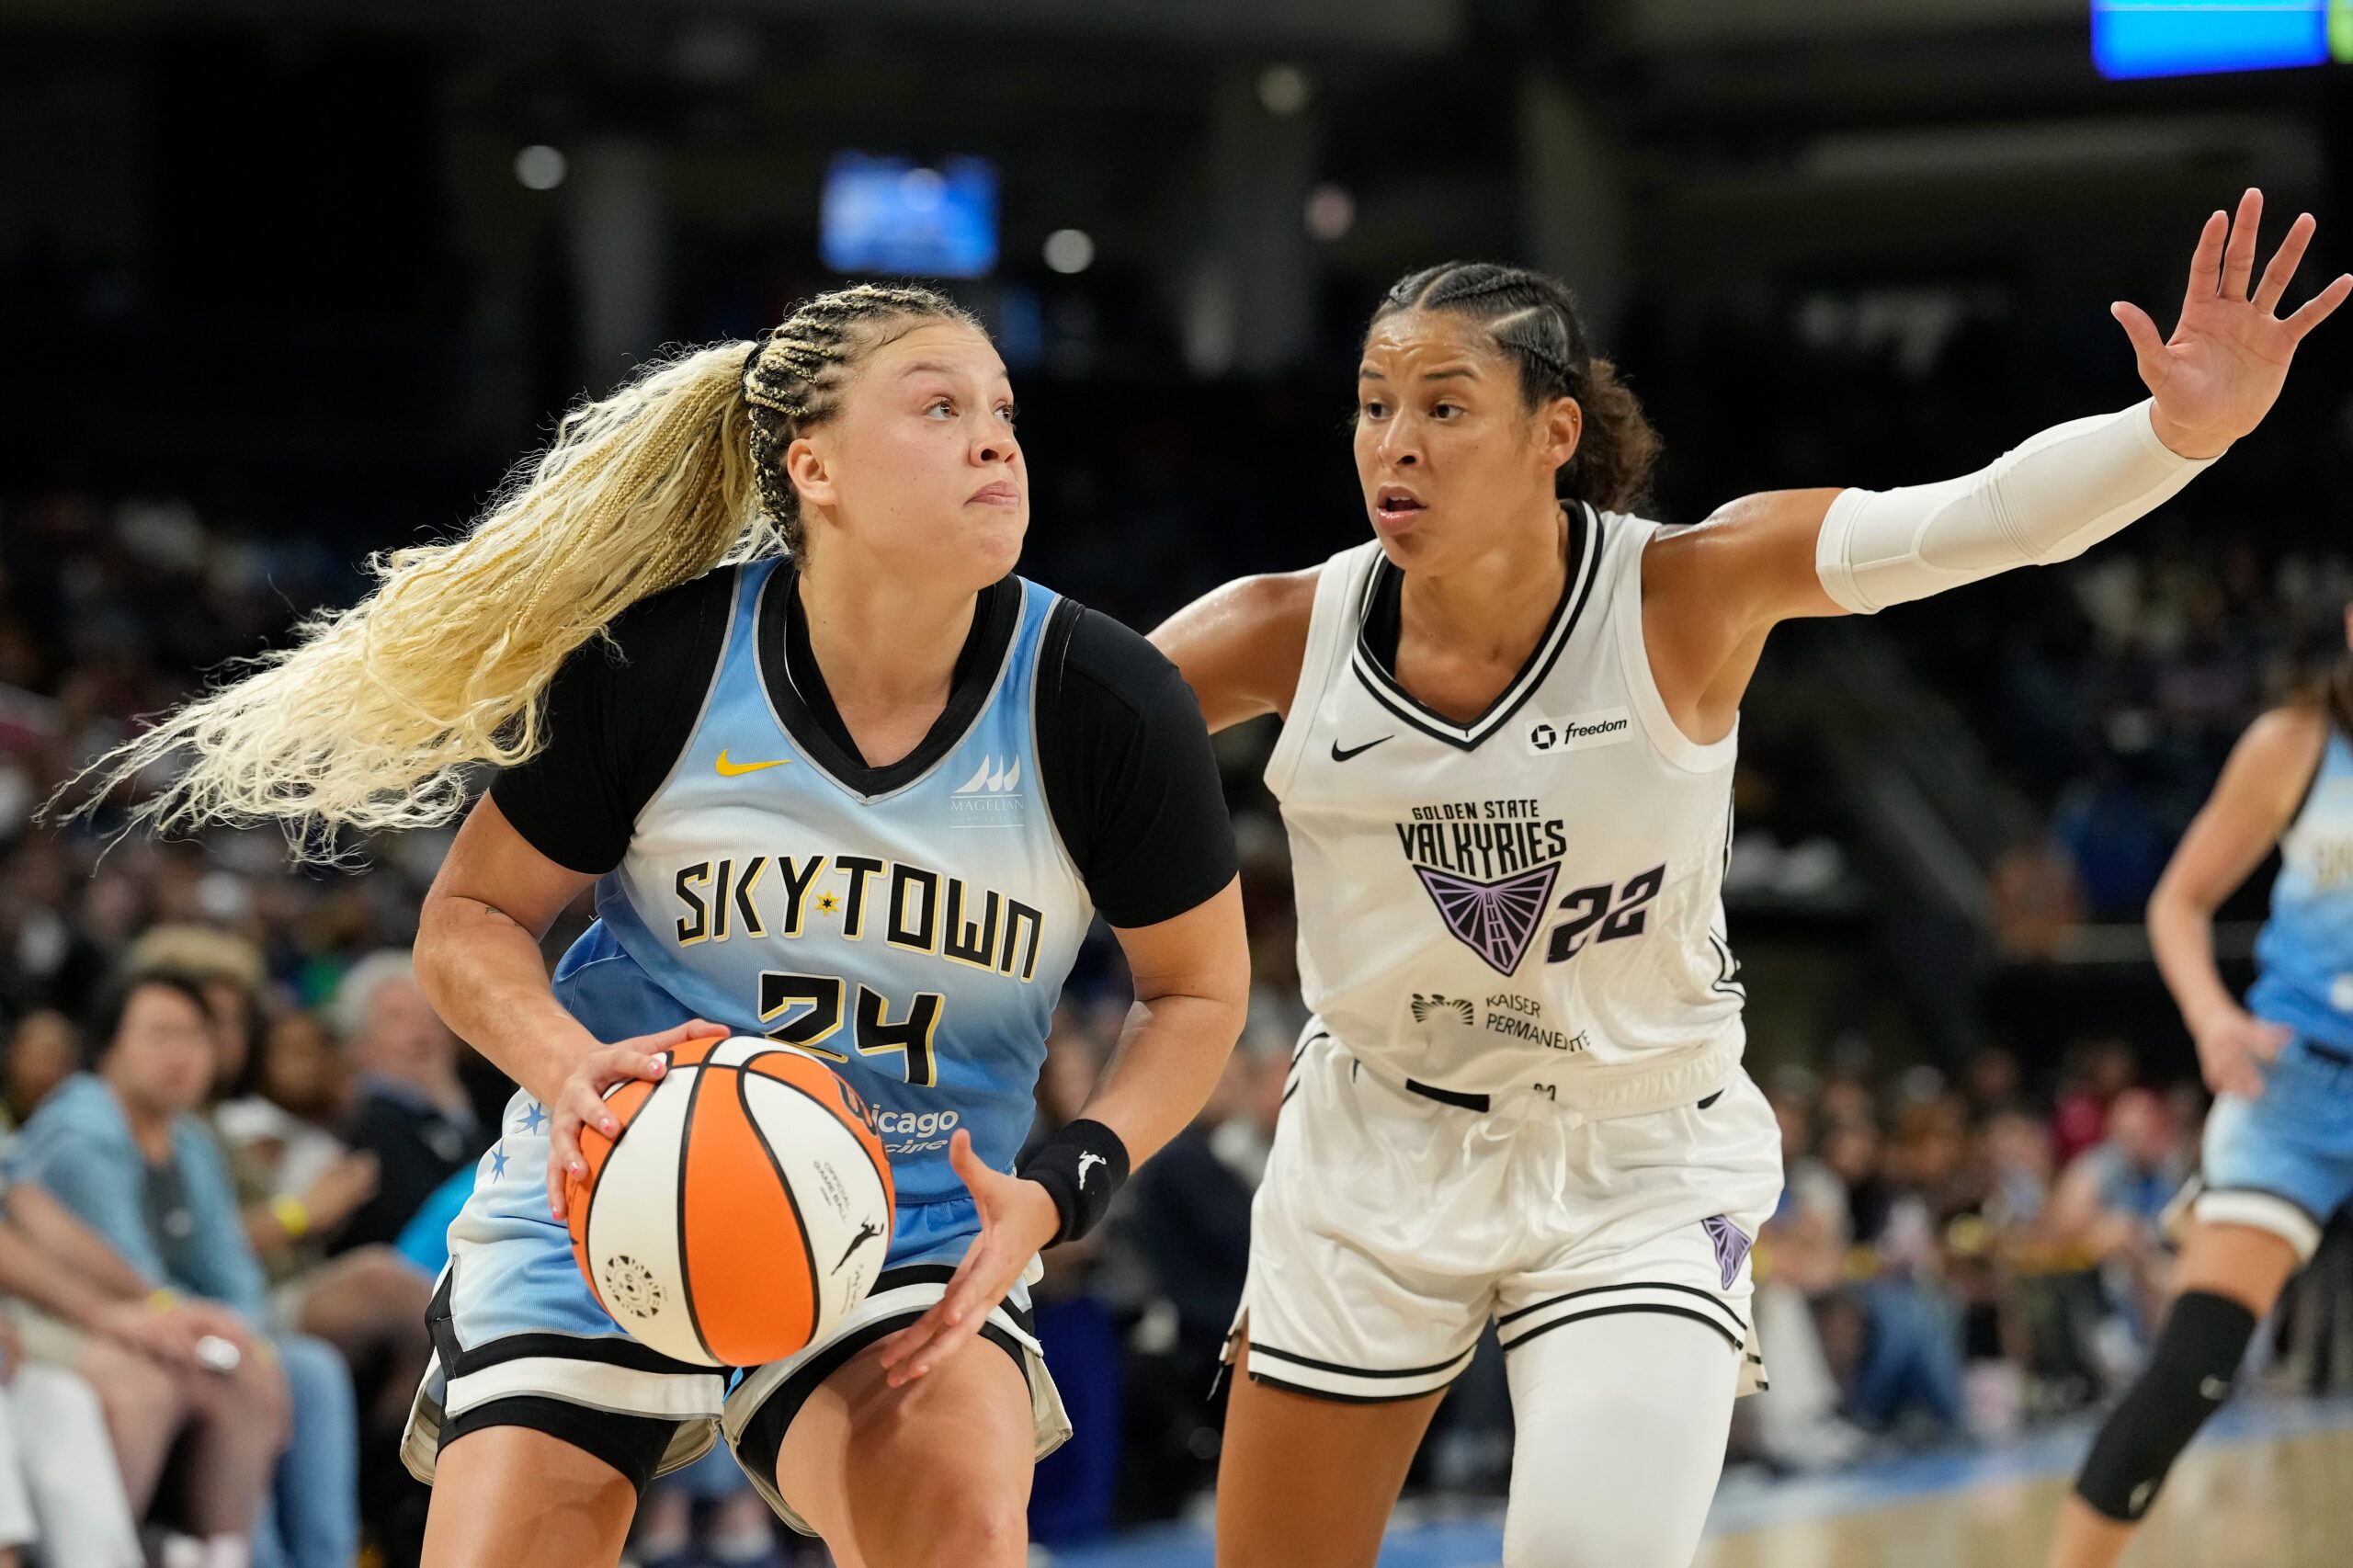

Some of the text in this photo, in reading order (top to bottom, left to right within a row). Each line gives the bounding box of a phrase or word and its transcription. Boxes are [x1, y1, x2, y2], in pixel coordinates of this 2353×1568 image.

[1564, 719, 1627, 744] freedom
[950, 799, 1024, 812] MAGELLAN
[1412, 799, 1540, 821] GOLDEN STATE
[1395, 819, 1567, 880] VALKYRIES
[1545, 860, 1667, 965] 22
[1486, 994, 1540, 1018] KAISER
[757, 970, 946, 1087] 24
[871, 1103, 959, 1138] icago
